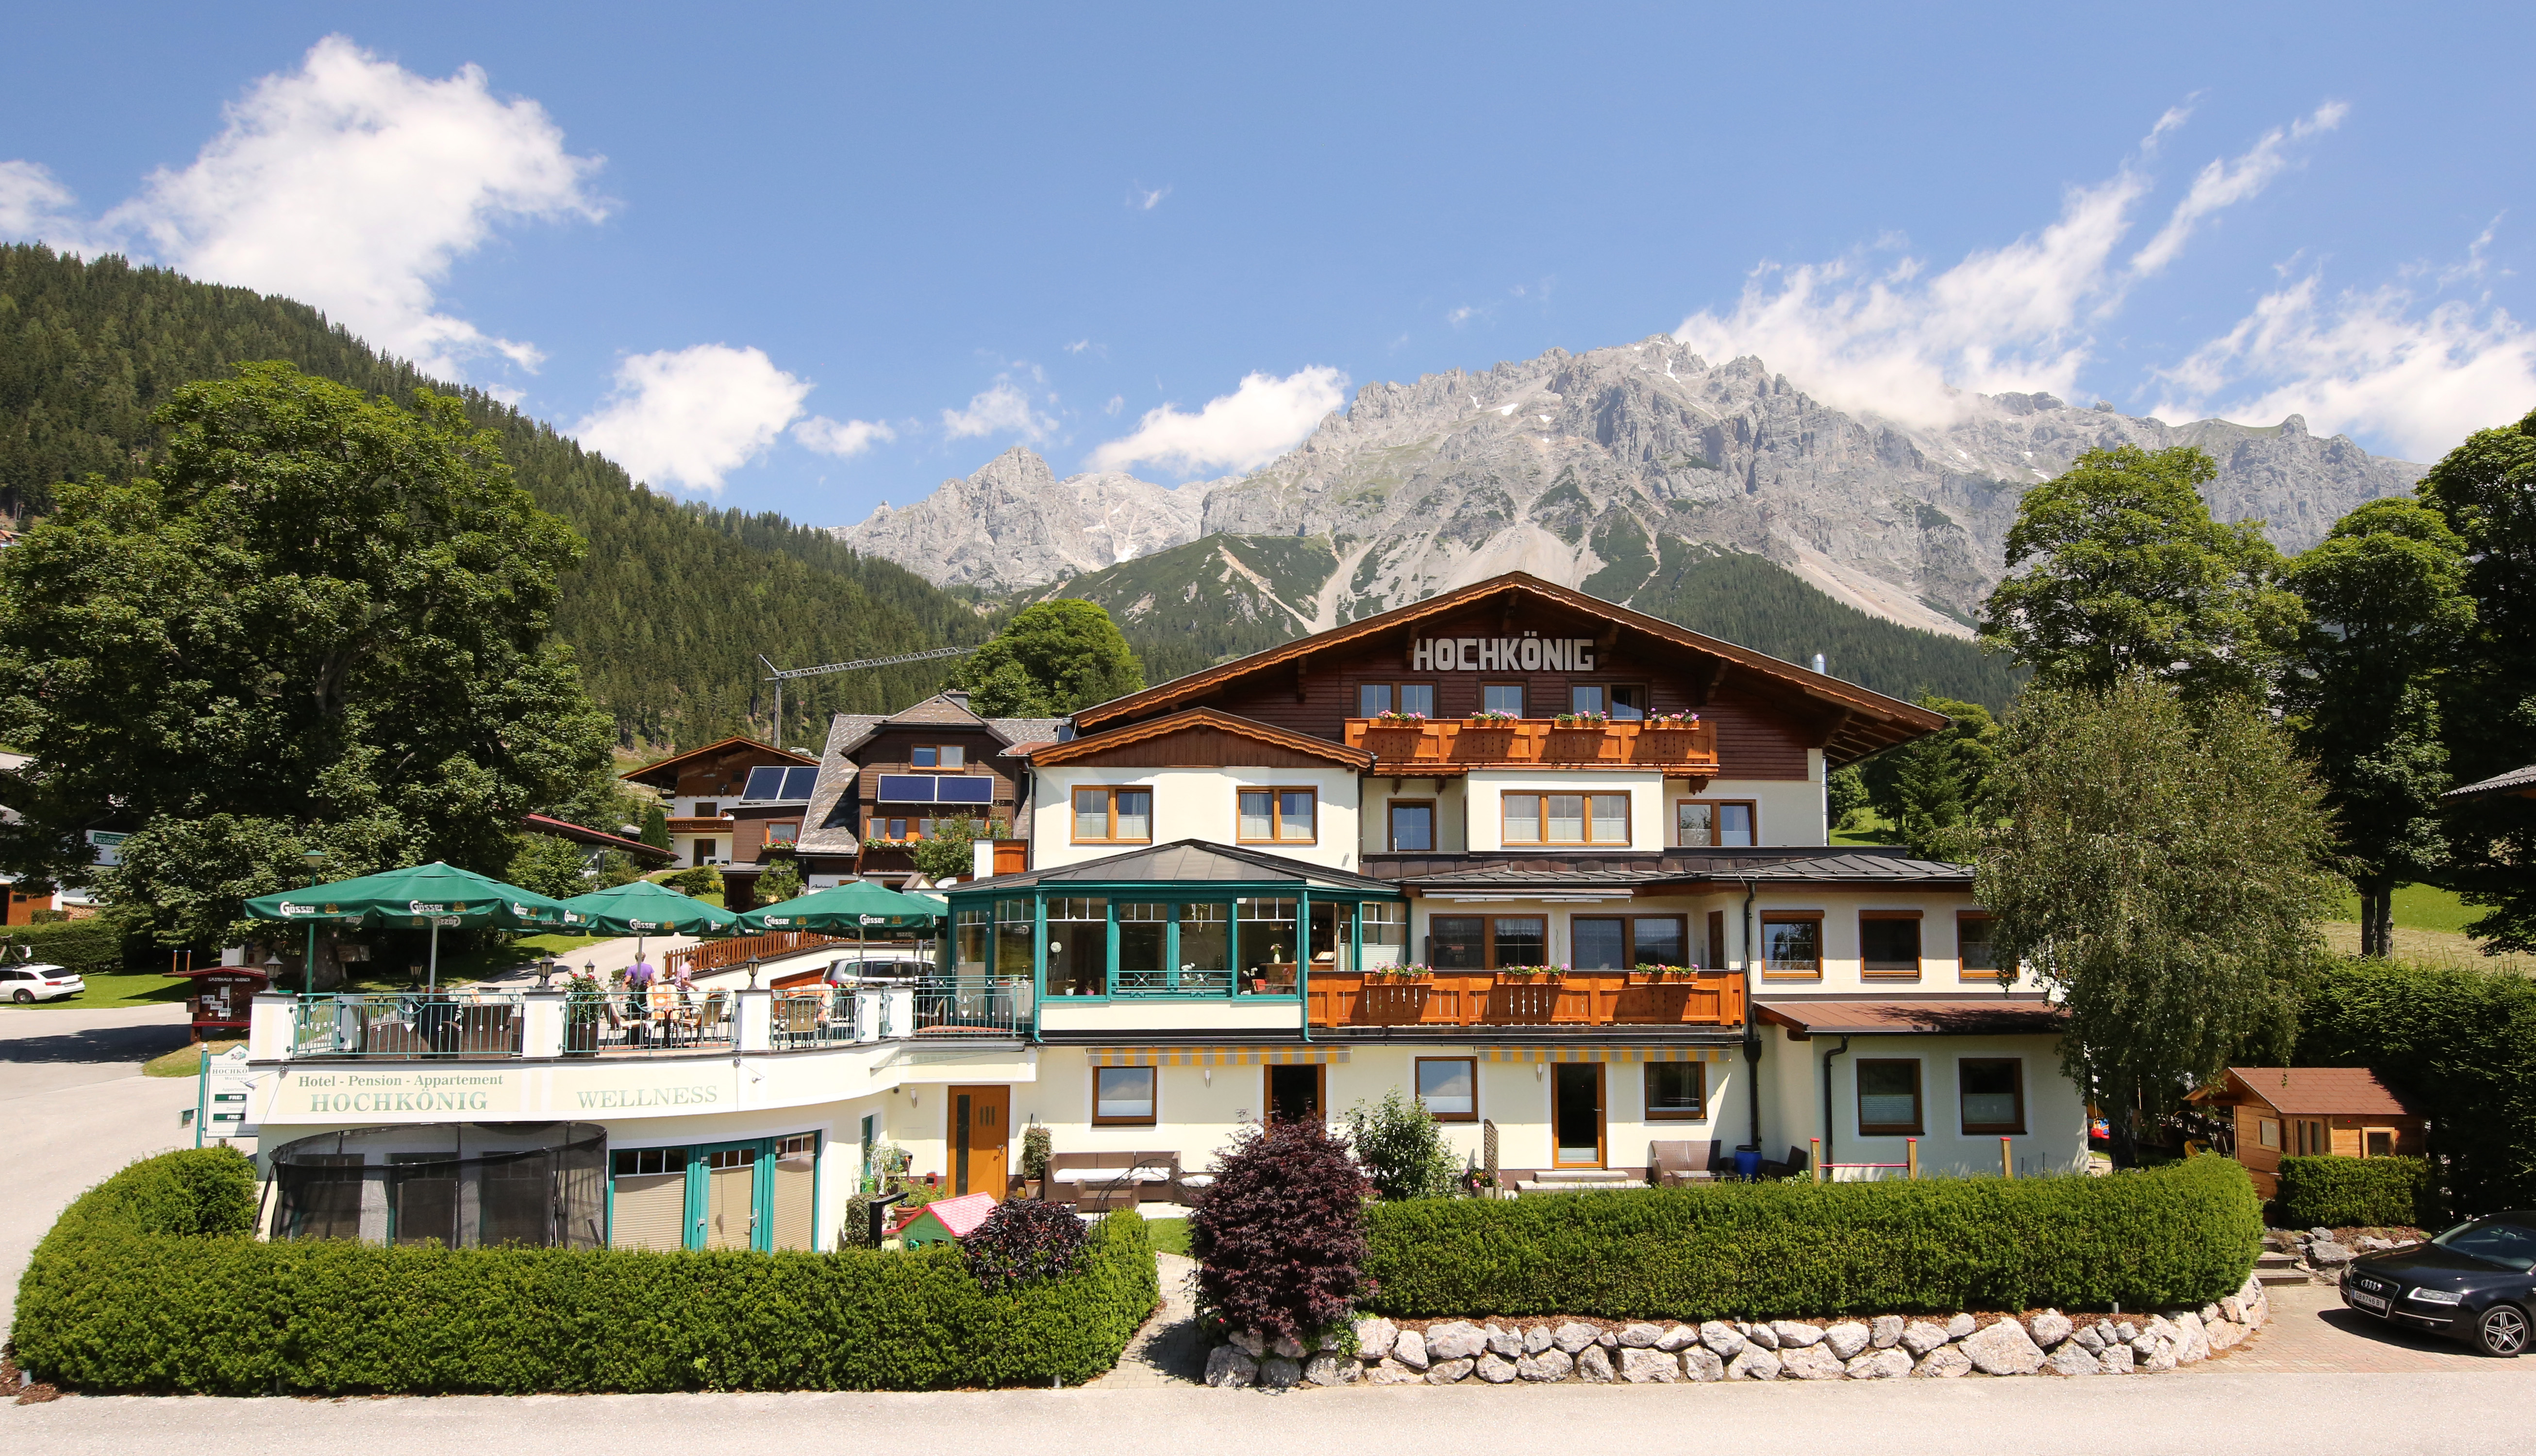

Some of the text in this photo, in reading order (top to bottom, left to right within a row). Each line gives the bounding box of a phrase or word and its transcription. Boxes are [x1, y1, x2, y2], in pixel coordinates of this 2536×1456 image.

[1413, 631, 1594, 671] HOCHKÖNIG
[280, 901, 315, 916] Gösser
[409, 900, 444, 914] Gösser
[629, 919, 656, 930] Gösser
[764, 915, 789, 927] Gösser
[859, 914, 884, 926] Gösser
[299, 1075, 335, 1087] Hotel
[348, 1075, 402, 1086] Pension
[414, 1074, 503, 1088] Appartement
[310, 1088, 488, 1111] HOCHKÖNIG
[577, 1085, 717, 1109] WELLNESS
[2366, 1296, 2375, 1304] 746
